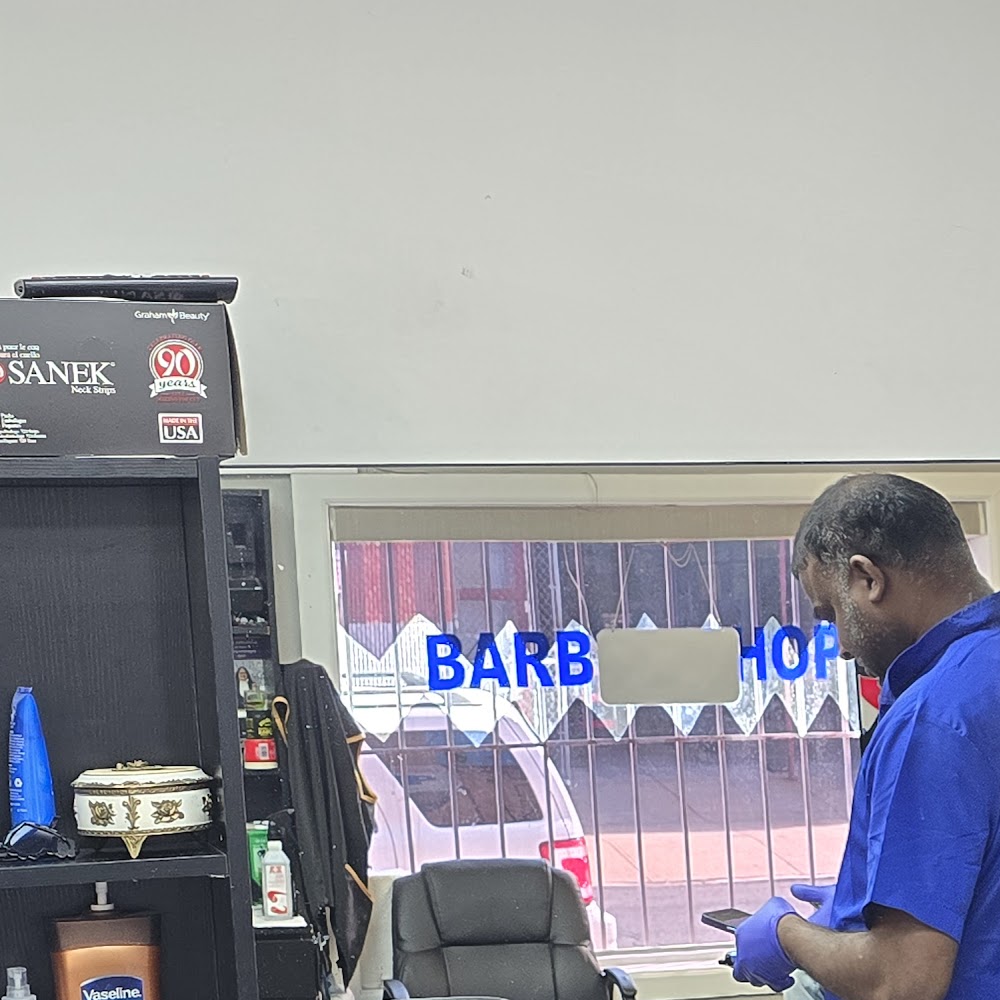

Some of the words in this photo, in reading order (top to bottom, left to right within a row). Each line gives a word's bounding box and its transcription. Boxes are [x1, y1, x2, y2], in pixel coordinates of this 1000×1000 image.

[134, 310, 168, 319] Graham
[179, 311, 210, 321] Beauty
[157, 348, 196, 377] 90
[8, 360, 114, 385] SANEK
[71, 385, 92, 394] Neck
[93, 386, 116, 395] Strips
[158, 379, 197, 389] years
[163, 426, 198, 440] USA
[426, 630, 593, 691] BARB
[740, 622, 840, 681] HOP
[82, 987, 142, 1000] Vaseline
